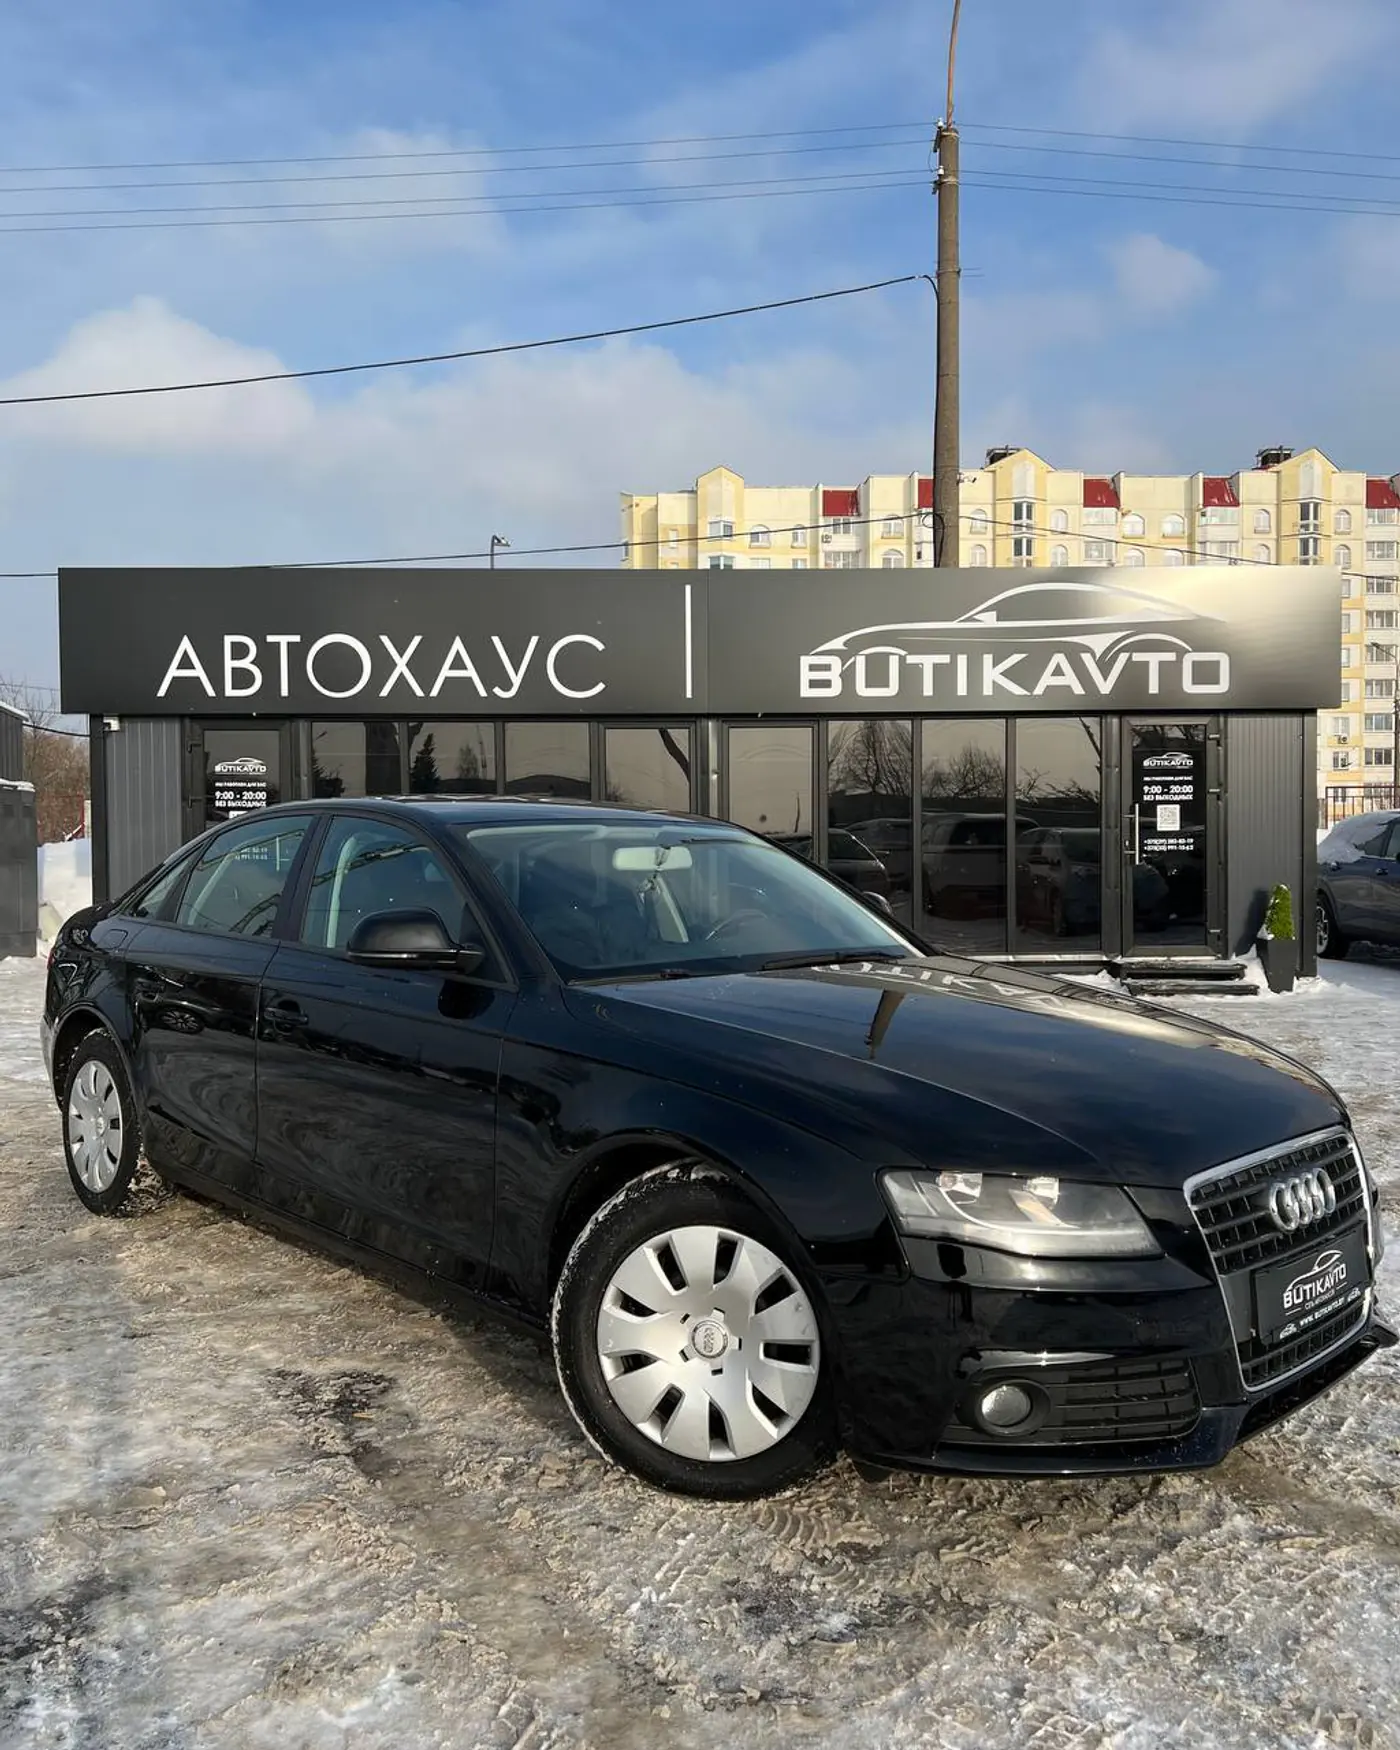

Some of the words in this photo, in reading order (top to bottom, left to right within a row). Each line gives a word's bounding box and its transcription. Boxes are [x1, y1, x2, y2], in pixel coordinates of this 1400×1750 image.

[156, 633, 606, 699] АВТОХАУС
[799, 650, 1230, 698] BUTIKAVTO
[1143, 759, 1193, 767] BUTIKAVTO
[215, 765, 267, 773] BUTIKAVTO
[1143, 785, 1162, 794] 9:00
[1169, 785, 1193, 794] 20:00
[215, 791, 234, 800] 9:00
[242, 791, 267, 800] 20:00
[1283, 1263, 1347, 1309] BUTIKAVTO
